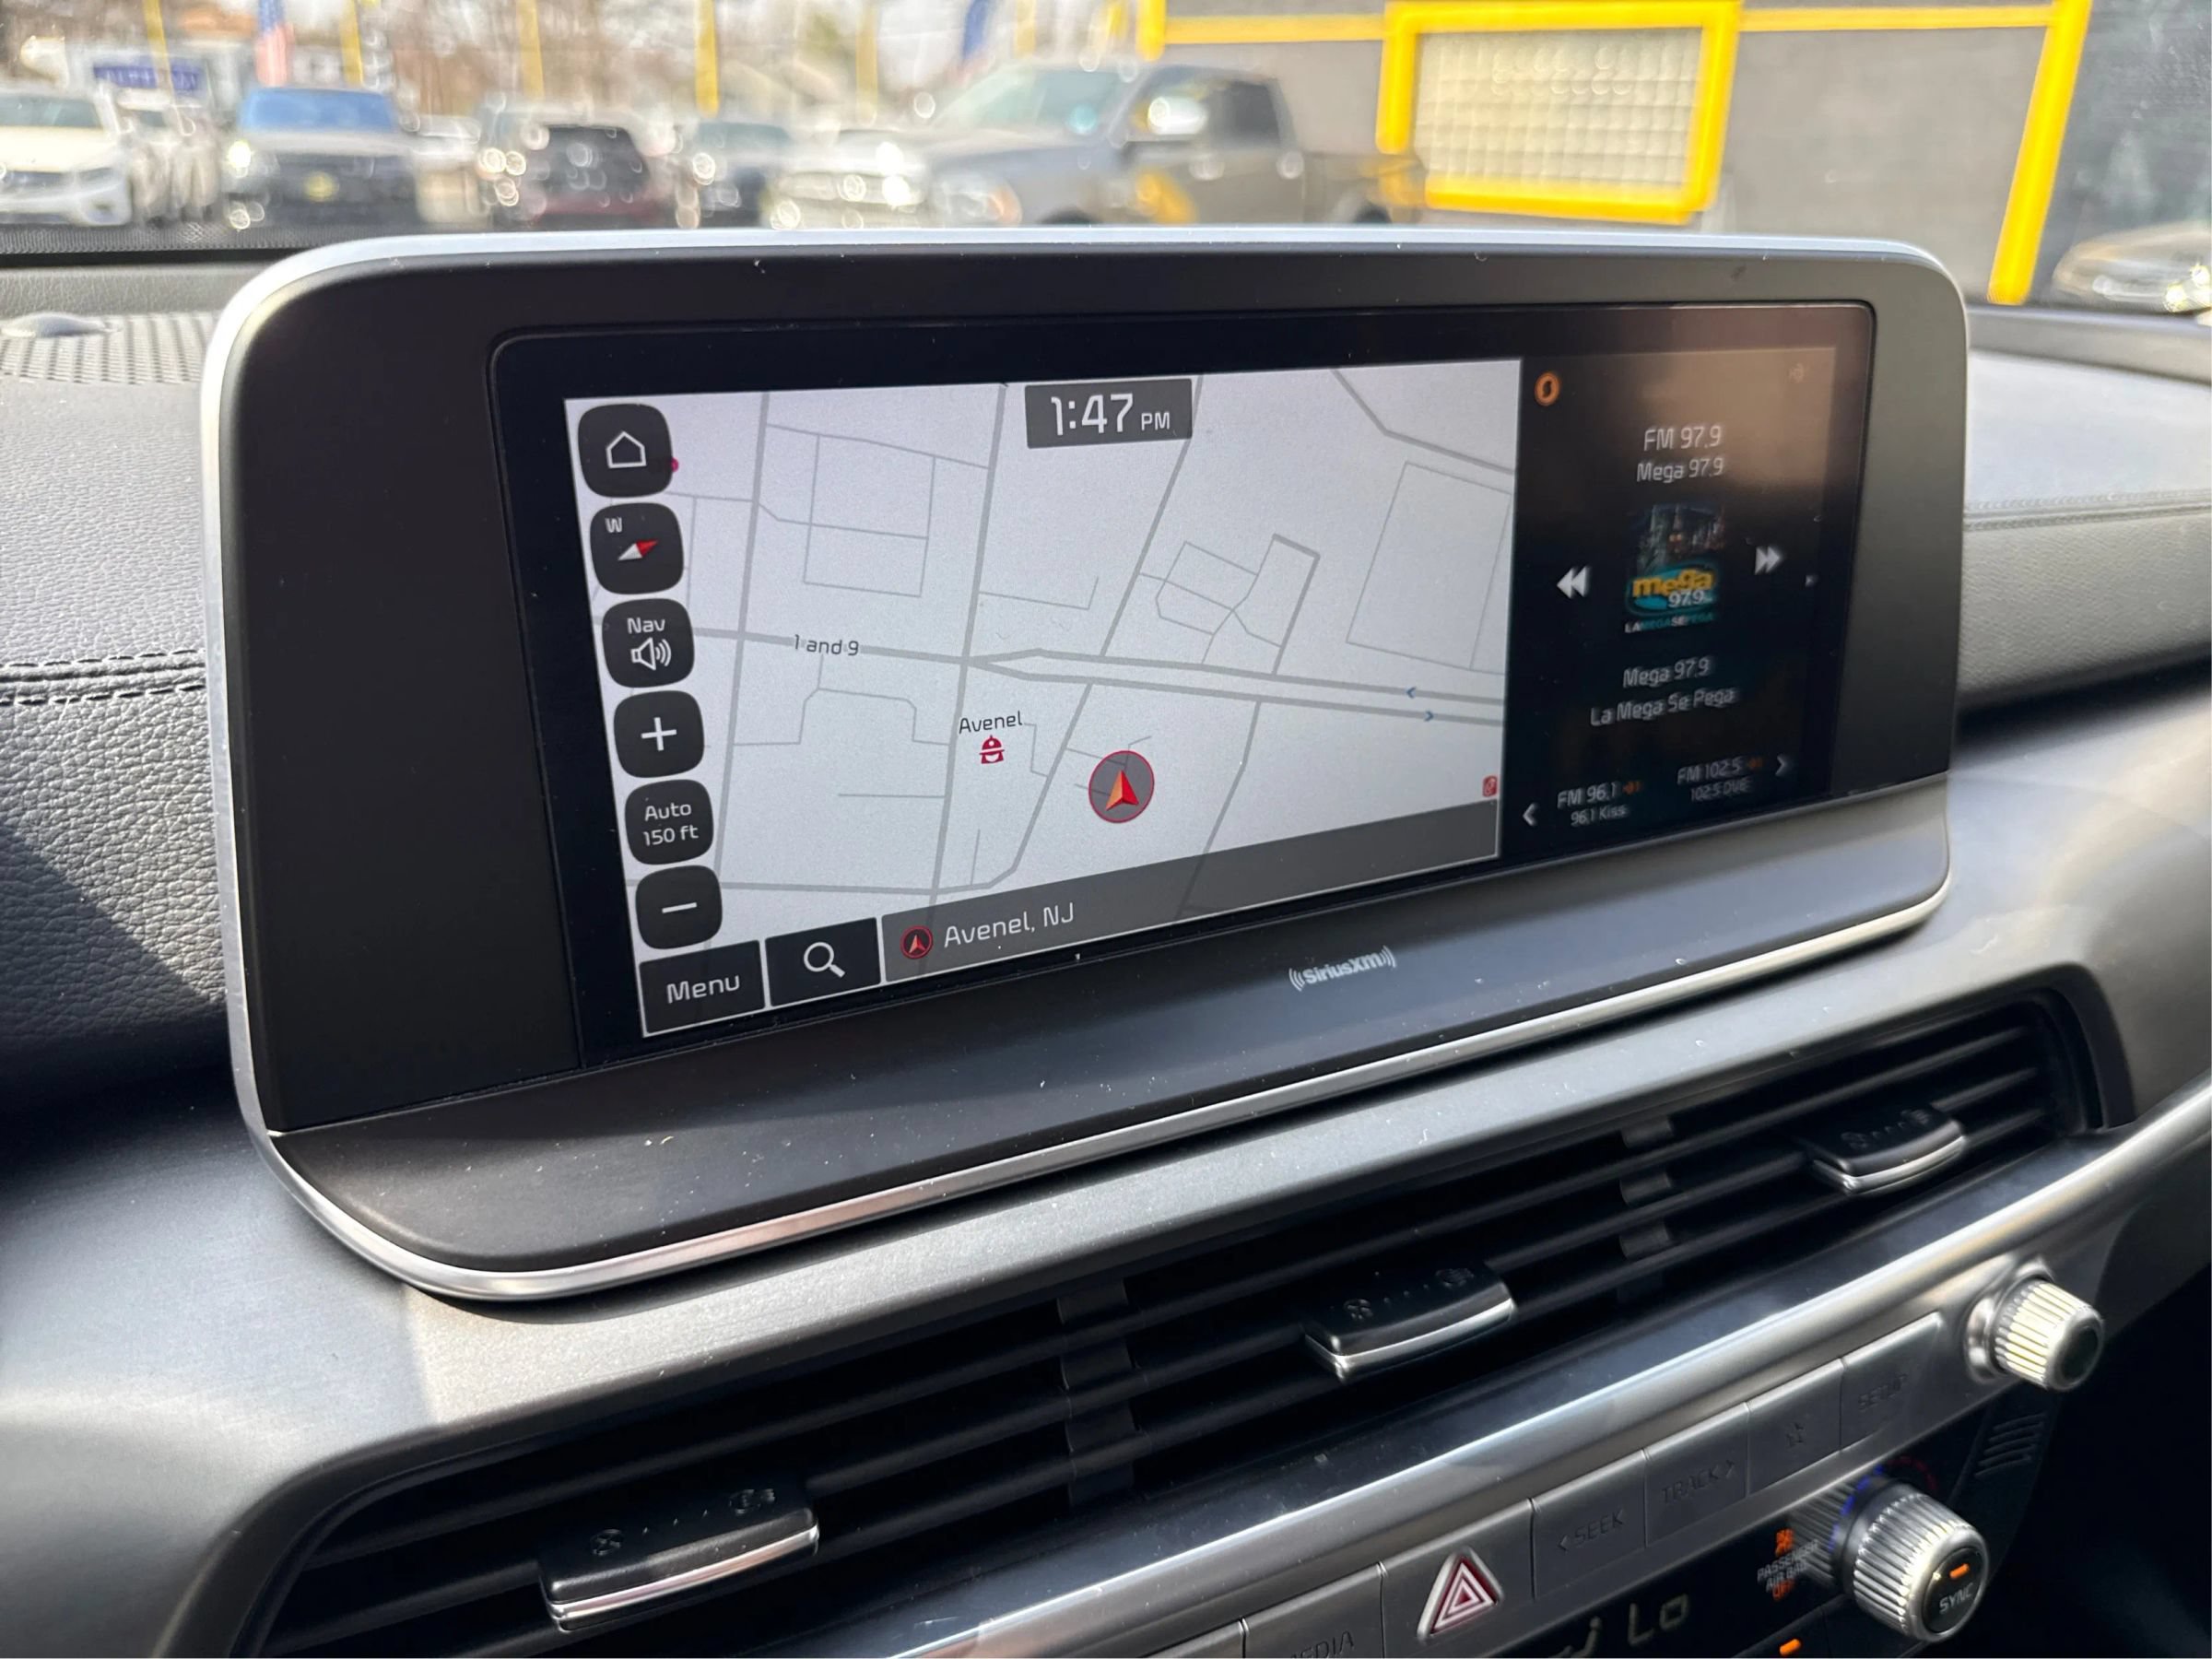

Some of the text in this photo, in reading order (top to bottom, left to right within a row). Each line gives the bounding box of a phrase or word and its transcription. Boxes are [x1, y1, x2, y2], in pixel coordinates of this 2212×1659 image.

[1051, 393, 1171, 437] 1:47 PM
[1644, 425, 1723, 452] FM 97.9
[1637, 457, 1724, 484] Mega 97.9
[605, 516, 624, 534] W
[1631, 569, 1712, 598] mega
[627, 617, 666, 635] Nav
[794, 634, 860, 656] 1 and 9
[1623, 656, 1712, 688] Mega 97.9
[1590, 688, 1739, 726] La Mega Se Pega
[959, 711, 1023, 735] Avenel
[1677, 765, 1701, 784] FM
[1557, 782, 1618, 809] FM 96.1
[644, 799, 692, 821] Auto
[1571, 804, 1629, 827] 96.1 Kiss
[642, 822, 699, 846] 150 ft
[944, 901, 1076, 949] Avenel, NJ
[666, 972, 741, 1004] Menu
[1662, 1465, 1720, 1504] TRACK
[1574, 1508, 1624, 1546] SEEK
[1938, 1582, 1974, 1615] SYNC
